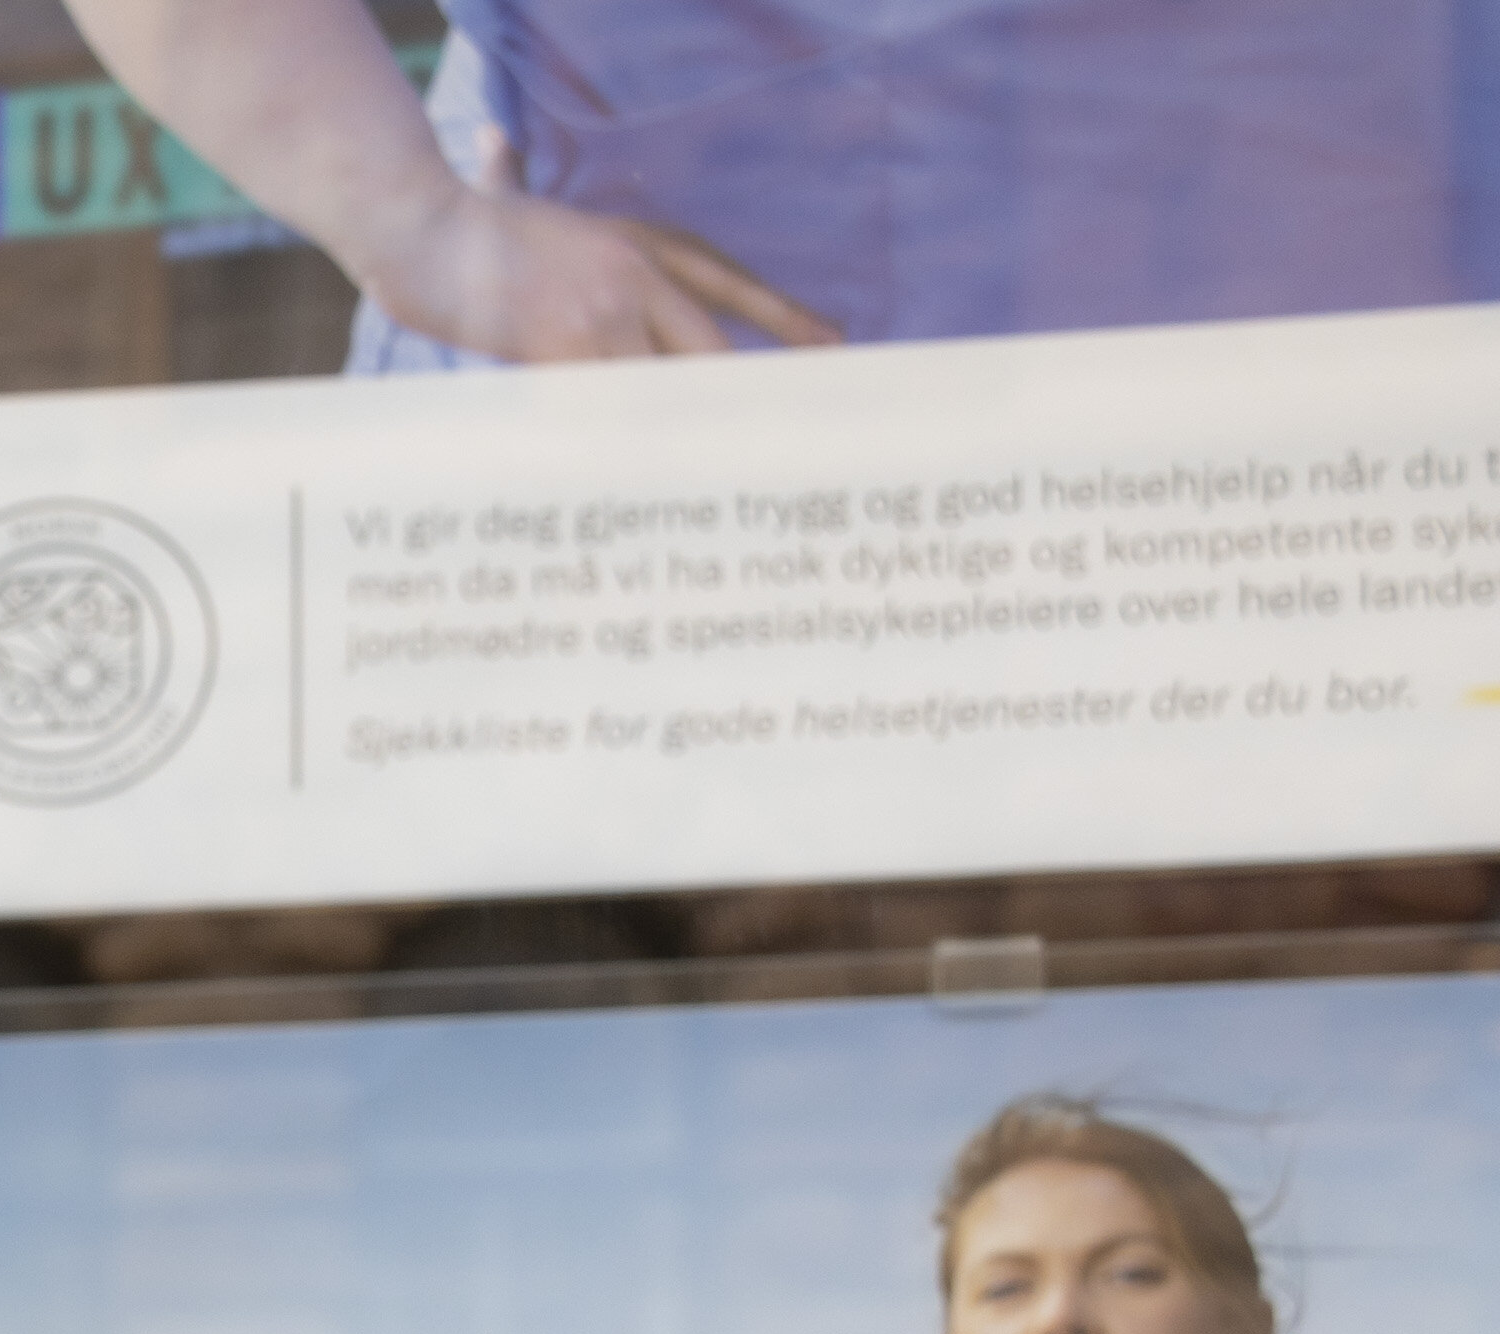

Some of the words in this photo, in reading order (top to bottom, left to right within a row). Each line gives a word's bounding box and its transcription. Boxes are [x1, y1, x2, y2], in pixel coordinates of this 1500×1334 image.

[343, 502, 392, 547] Vi
[403, 500, 461, 554] gir
[474, 497, 560, 547] deg
[573, 490, 720, 544] gjerne
[734, 483, 850, 533] trygg
[862, 483, 922, 527] og
[935, 469, 1024, 525] god
[1039, 456, 1292, 511] helsehjelp
[1307, 449, 1388, 495] når
[1402, 447, 1468, 490] du
[1412, 501, 1500, 555] syk
